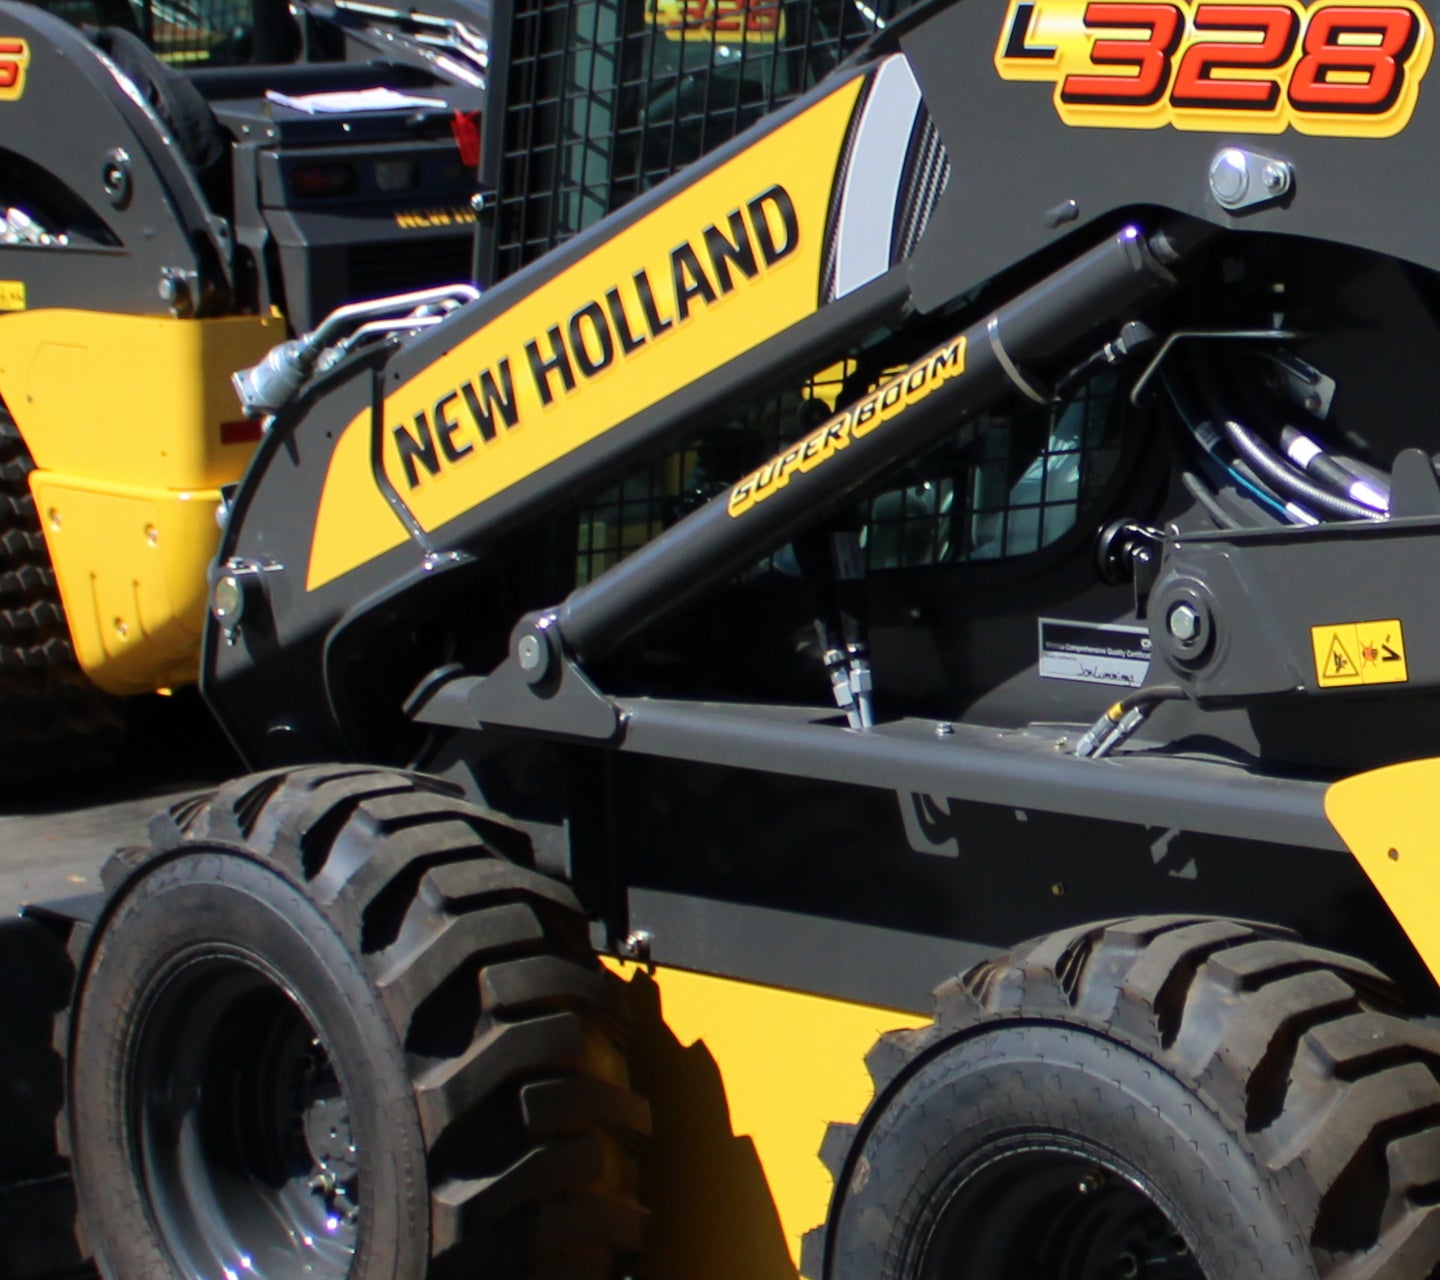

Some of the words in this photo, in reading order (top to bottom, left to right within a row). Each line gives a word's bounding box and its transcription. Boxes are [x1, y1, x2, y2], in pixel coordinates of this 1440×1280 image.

[1000, 0, 1424, 120] L328
[393, 357, 519, 490] NEW
[524, 184, 800, 409] HOLLAND
[729, 414, 850, 514] SUPER
[853, 338, 966, 437] BOOM
